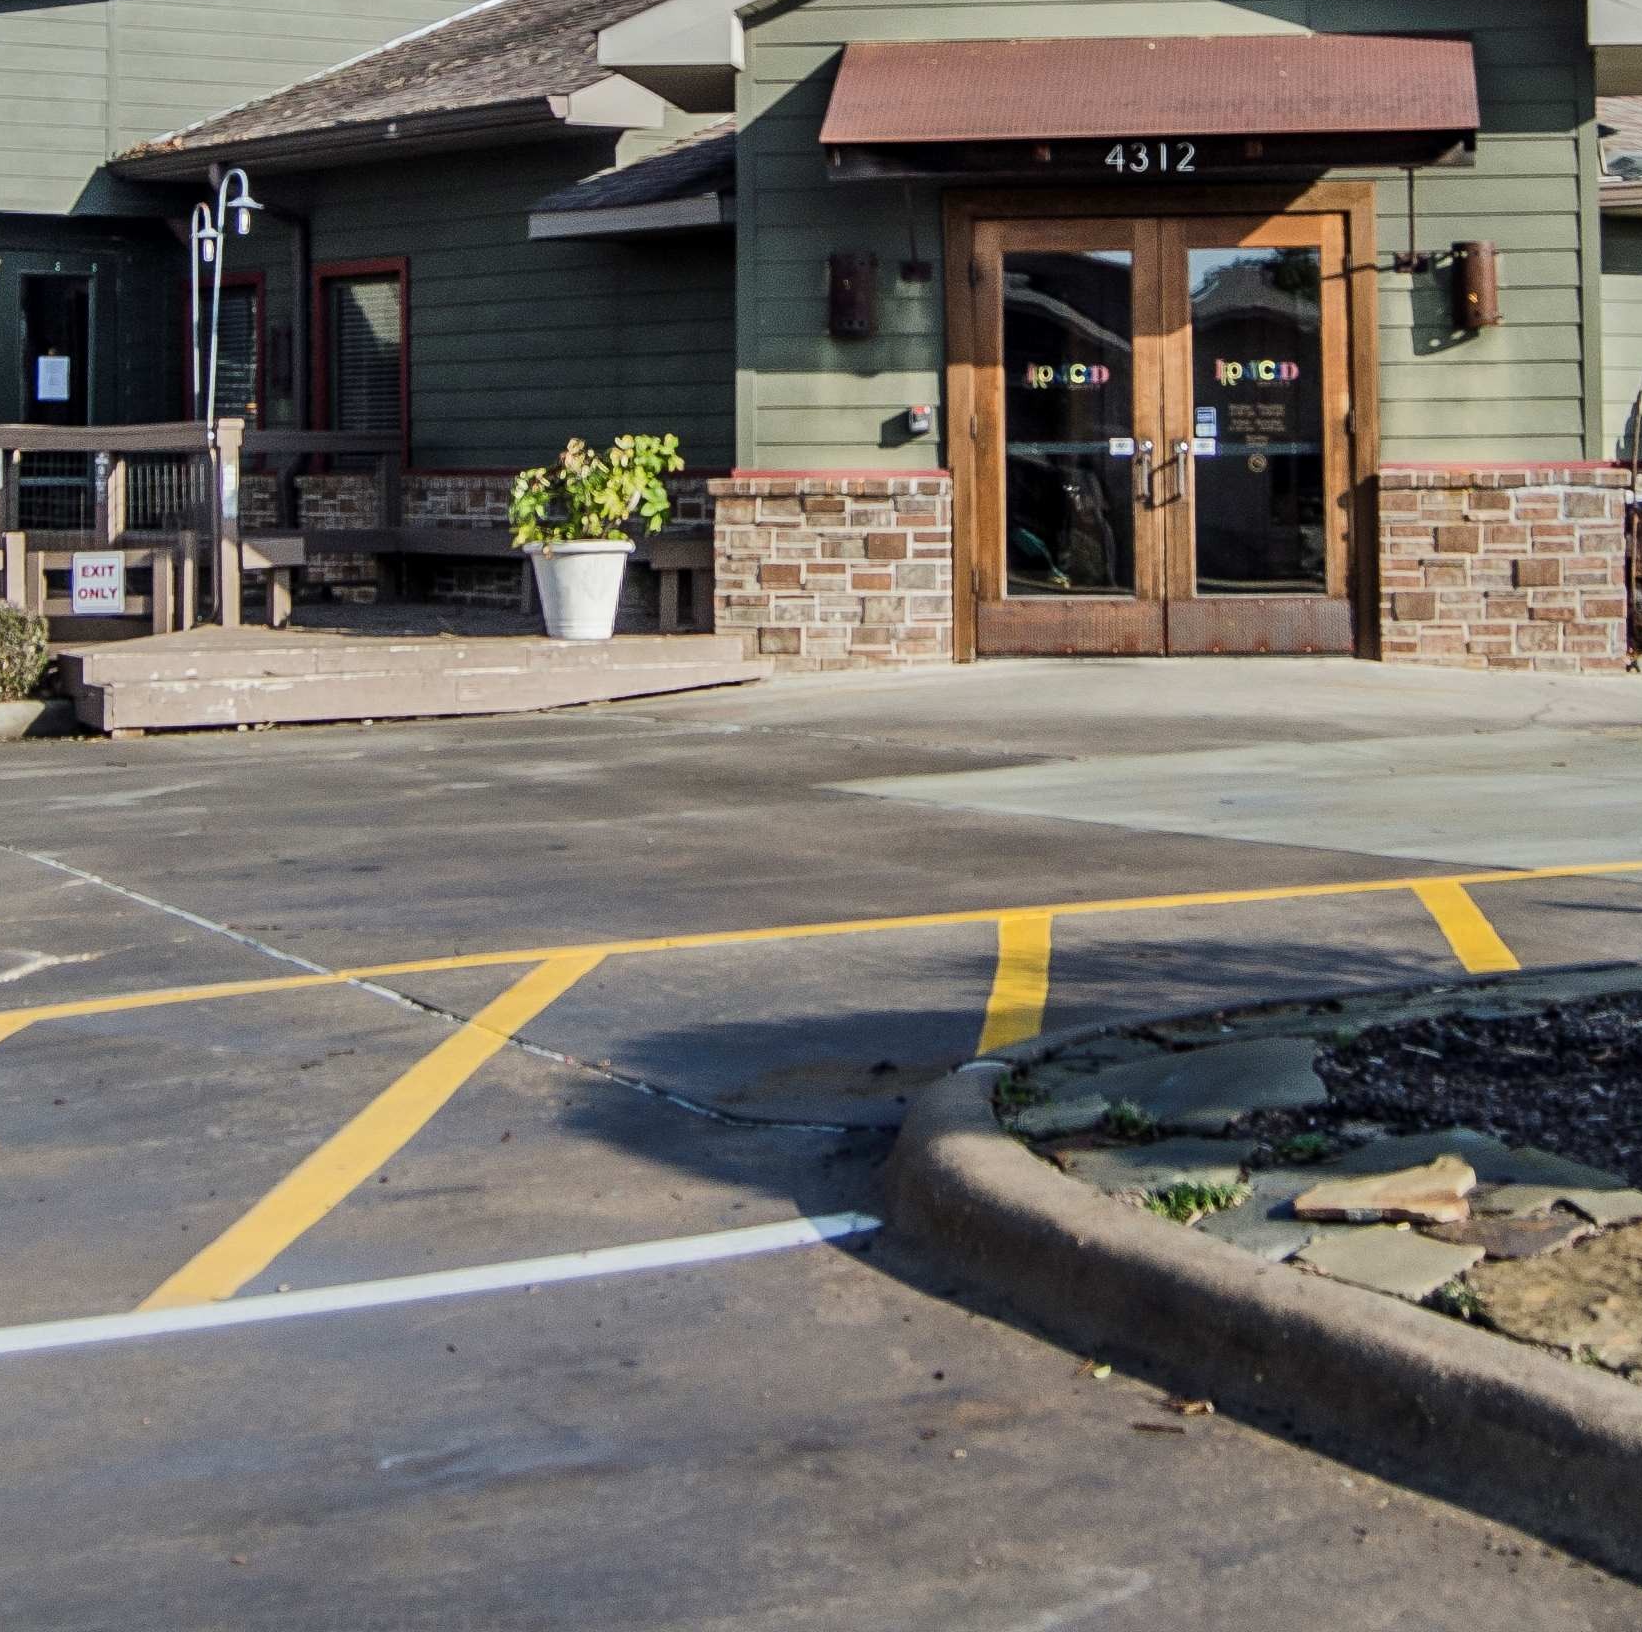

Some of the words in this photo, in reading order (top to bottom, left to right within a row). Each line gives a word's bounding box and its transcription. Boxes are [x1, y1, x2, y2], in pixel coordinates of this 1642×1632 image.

[1104, 142, 1196, 173] 4312
[1081, 565, 1114, 577] EXIT
[1078, 587, 1117, 599] ONLY
